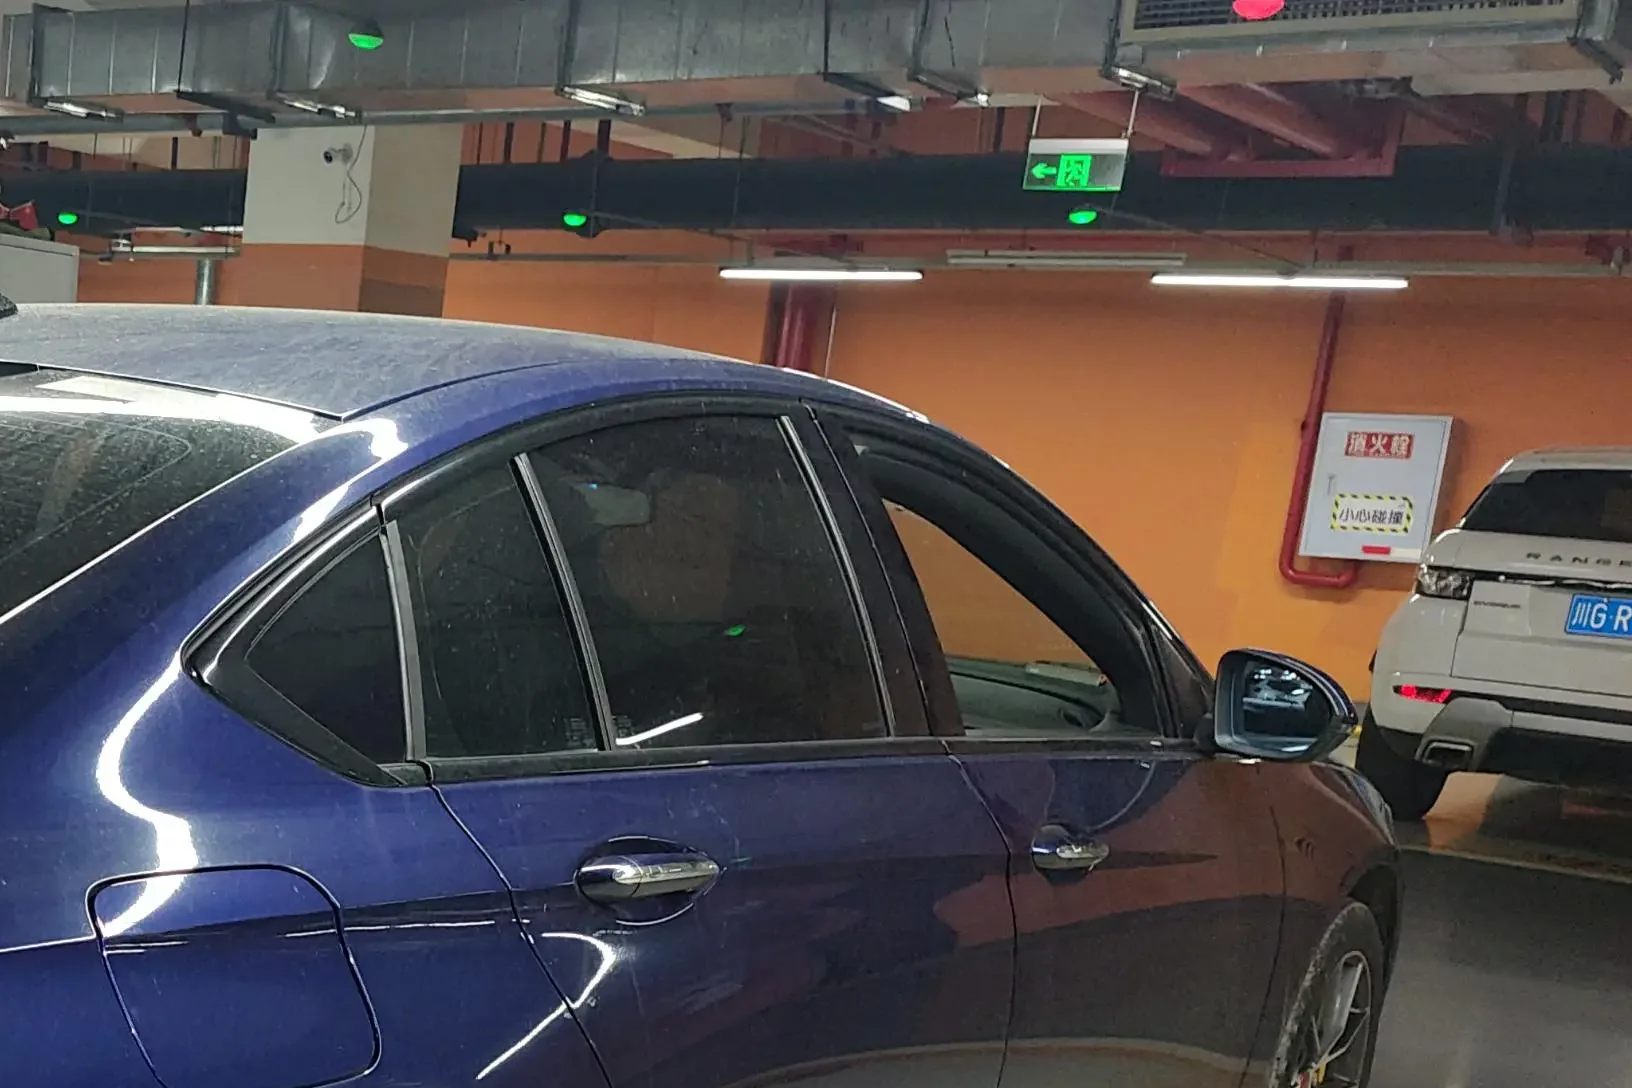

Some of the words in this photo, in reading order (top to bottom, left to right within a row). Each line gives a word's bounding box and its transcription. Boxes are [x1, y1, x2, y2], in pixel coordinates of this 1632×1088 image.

[1348, 432, 1409, 457] 消火栓
[1339, 507, 1404, 525] 小心碰撞
